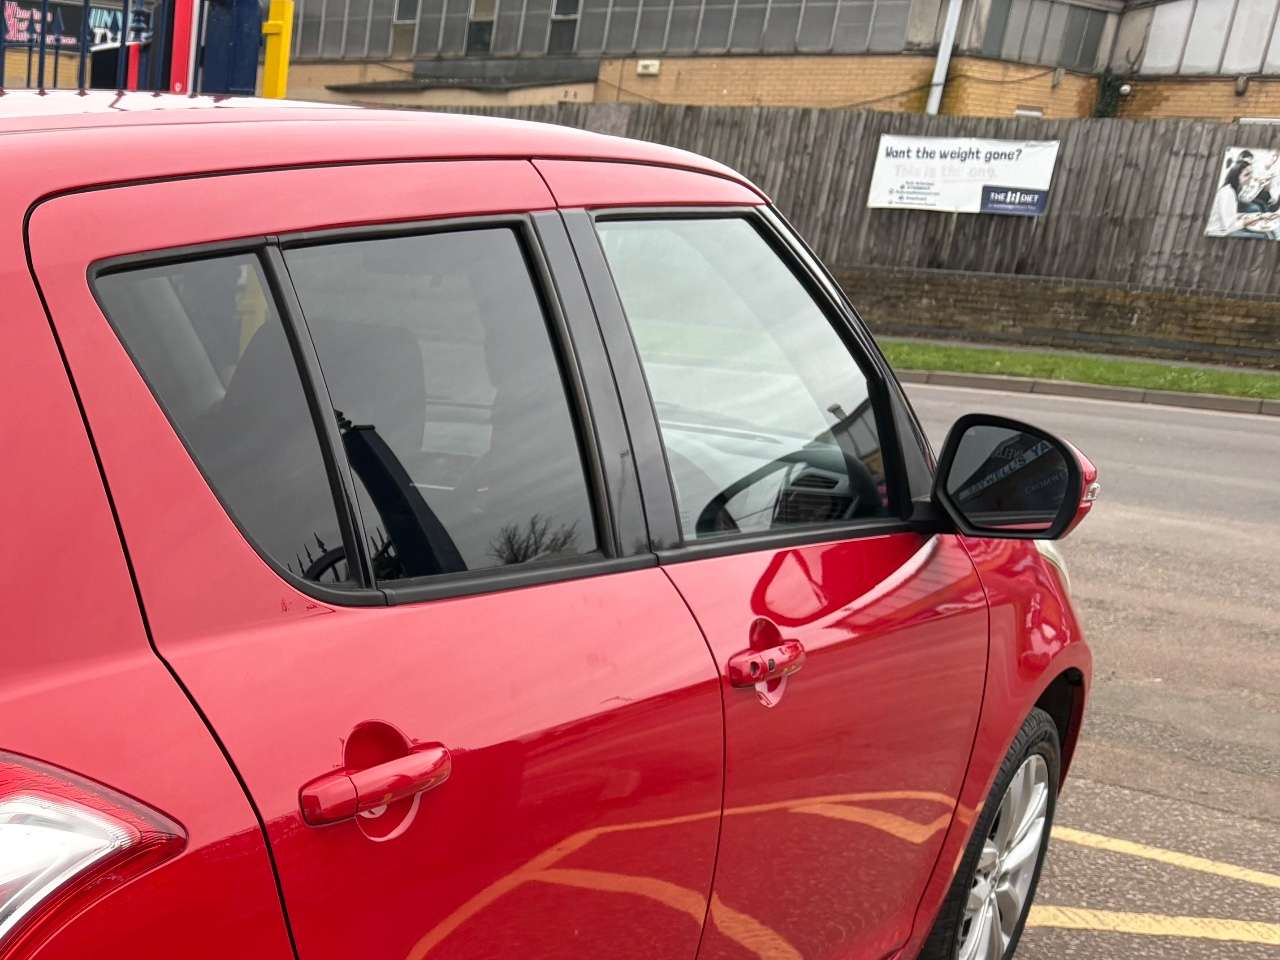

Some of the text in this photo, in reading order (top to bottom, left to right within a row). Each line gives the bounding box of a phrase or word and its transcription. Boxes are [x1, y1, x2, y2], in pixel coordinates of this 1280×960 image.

[885, 146, 1023, 163] Want the weight gone?
[990, 191, 1007, 202] THE
